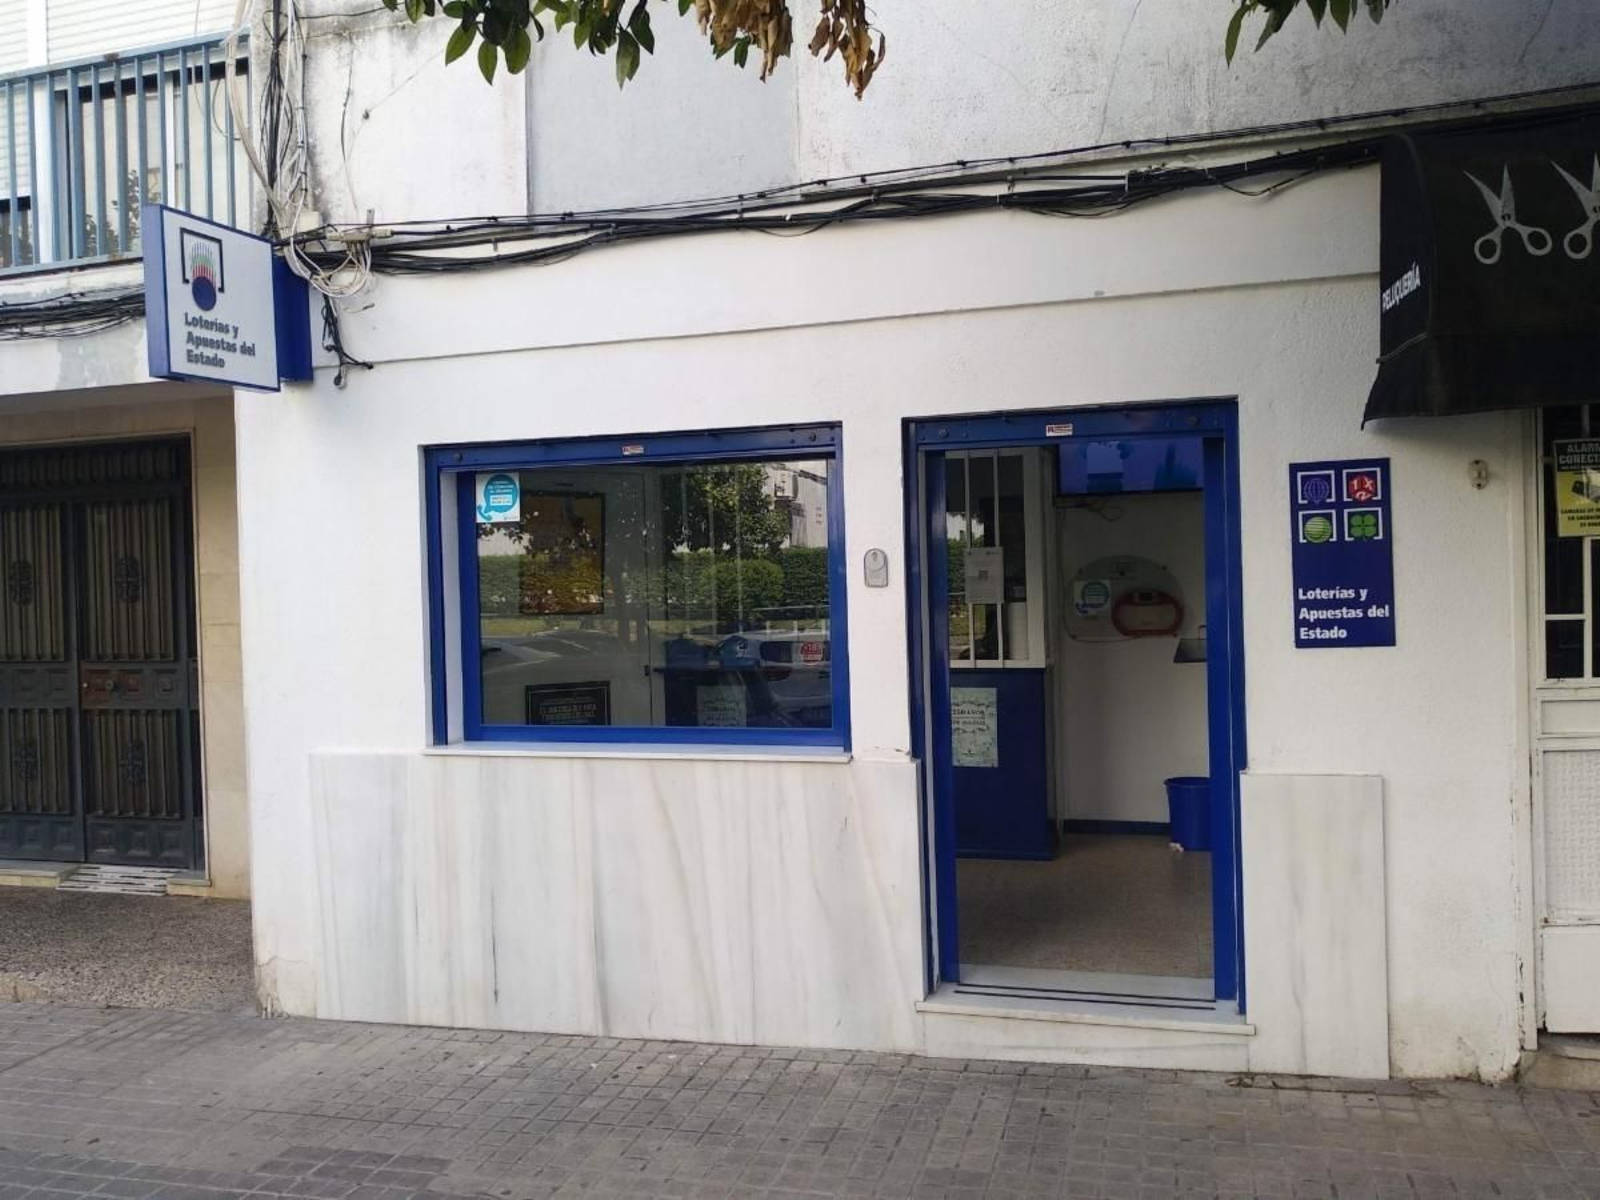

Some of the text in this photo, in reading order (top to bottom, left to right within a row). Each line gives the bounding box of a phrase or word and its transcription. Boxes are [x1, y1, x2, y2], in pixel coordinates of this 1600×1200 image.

[1382, 262, 1420, 313] PELUQUERÍA
[232, 325, 239, 339] y
[186, 331, 256, 356] Apuestas del
[186, 349, 225, 368] Estado
[1298, 586, 1368, 601] Loterías y
[1299, 604, 1389, 623] Apuestas del
[1300, 626, 1347, 640] Estado
